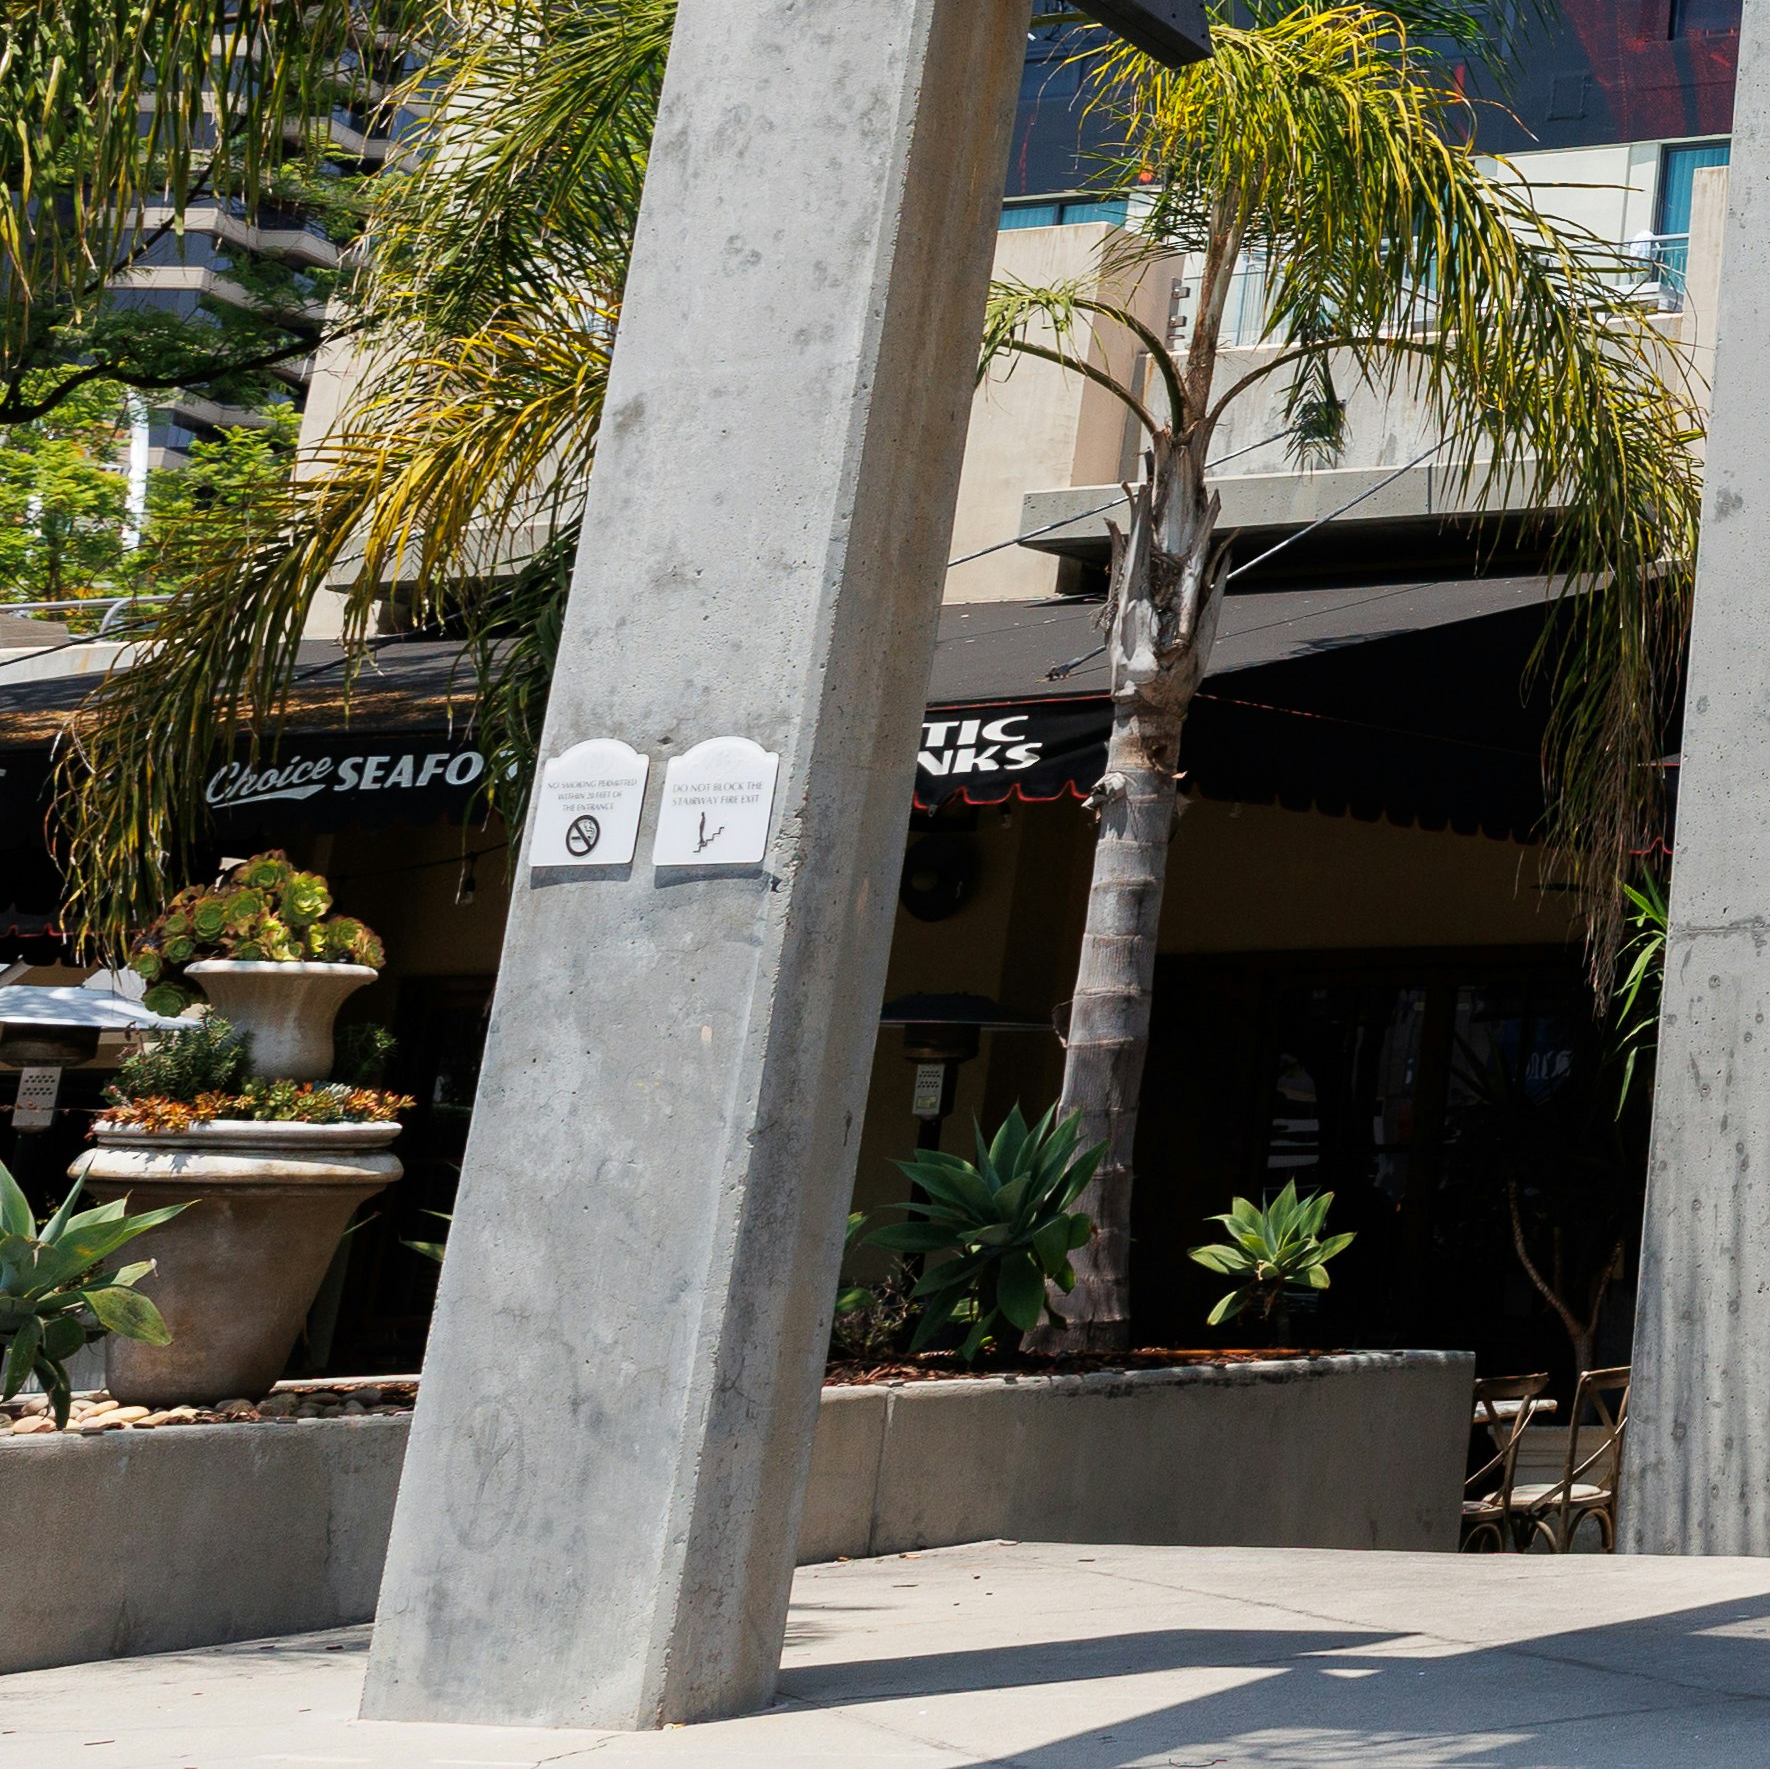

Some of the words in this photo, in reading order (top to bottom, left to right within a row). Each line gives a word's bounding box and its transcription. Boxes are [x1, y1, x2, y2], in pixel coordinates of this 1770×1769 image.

[205, 755, 335, 804] Choice
[334, 750, 520, 791] SEAFO
[547, 781, 560, 789] NO
[561, 780, 596, 789] SMOKING
[598, 778, 638, 788] PERMITTED
[672, 783, 689, 793] DO
[690, 783, 711, 793] NOT
[713, 781, 744, 792] BLOCK
[747, 781, 763, 790] THE
[595, 791, 611, 799] FEET
[612, 790, 622, 798] OF
[672, 796, 719, 806] STAIRWAY
[720, 795, 738, 804] FIRE
[741, 794, 760, 803] EXIT
[577, 802, 614, 811] ENTRANCE
